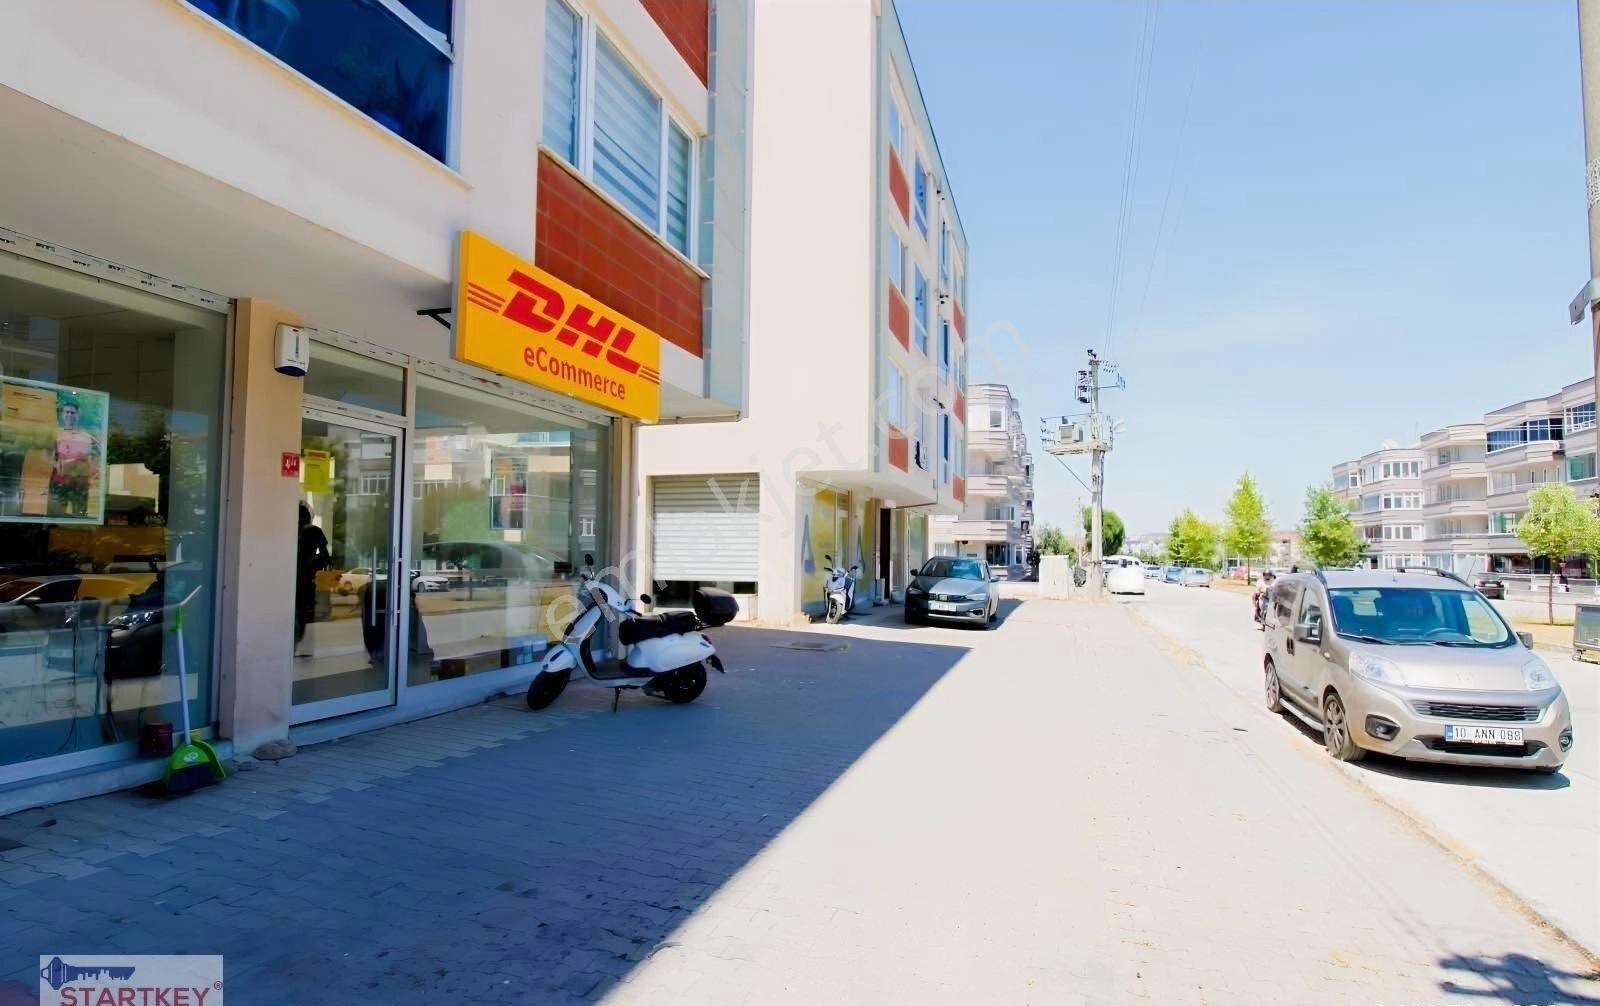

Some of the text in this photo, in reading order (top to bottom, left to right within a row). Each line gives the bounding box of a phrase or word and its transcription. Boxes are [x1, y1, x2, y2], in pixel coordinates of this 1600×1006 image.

[502, 269, 641, 375] DHL
[524, 346, 626, 400] eCommerce
[1455, 727, 1466, 738] 10
[1474, 728, 1495, 740] ANN
